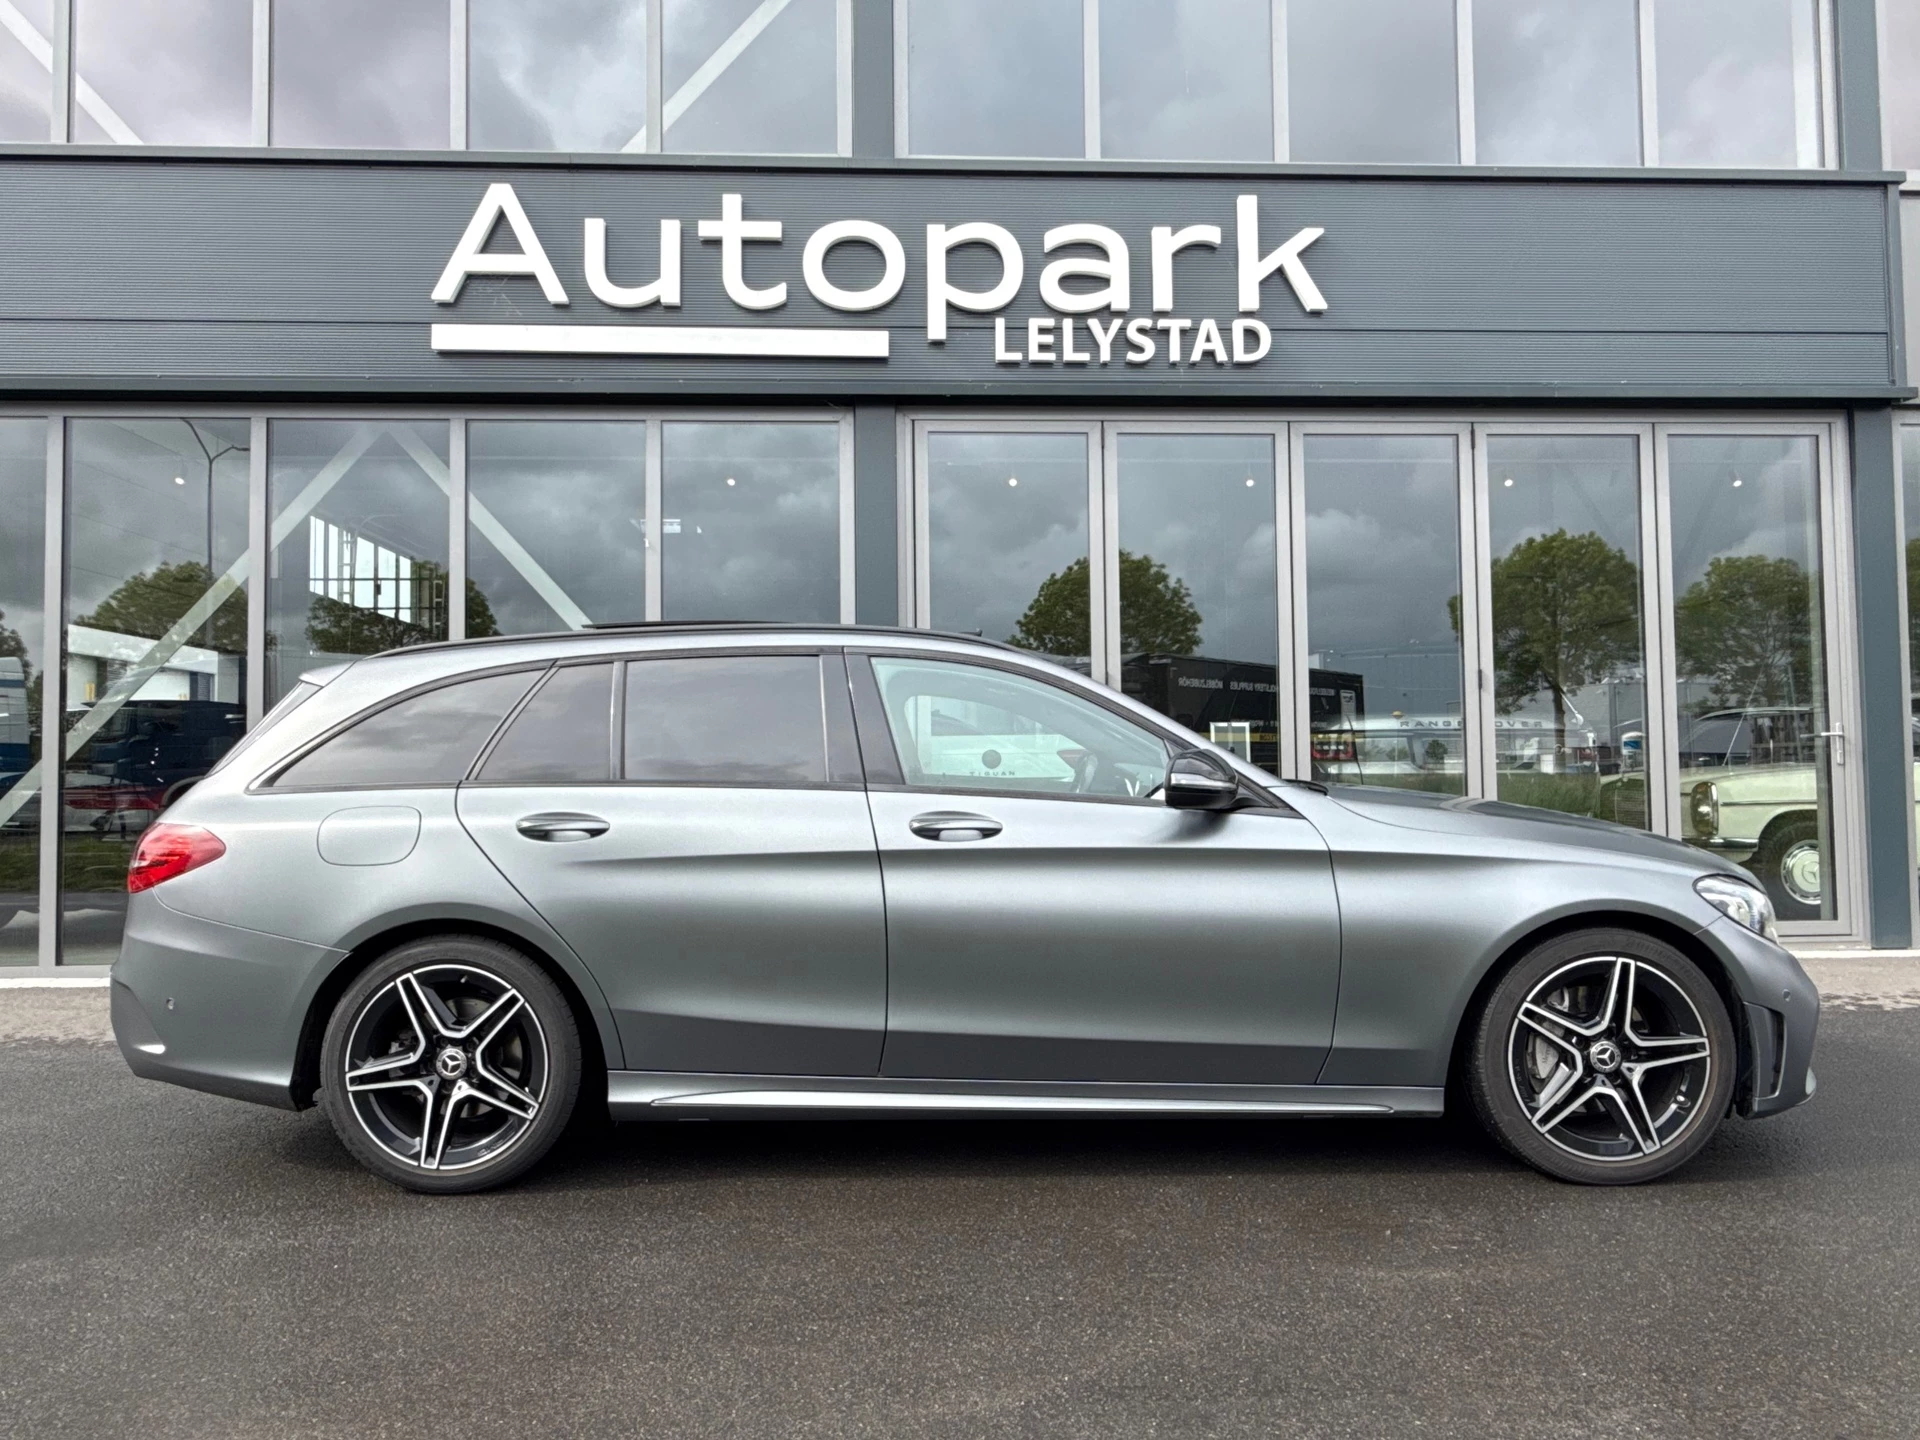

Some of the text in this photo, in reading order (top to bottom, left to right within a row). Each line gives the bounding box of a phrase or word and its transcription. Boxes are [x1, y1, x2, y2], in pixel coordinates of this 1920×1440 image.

[430, 182, 1328, 343] Autopark
[994, 316, 1274, 365] LELYSTAD
[1494, 720, 1543, 728] OVER
